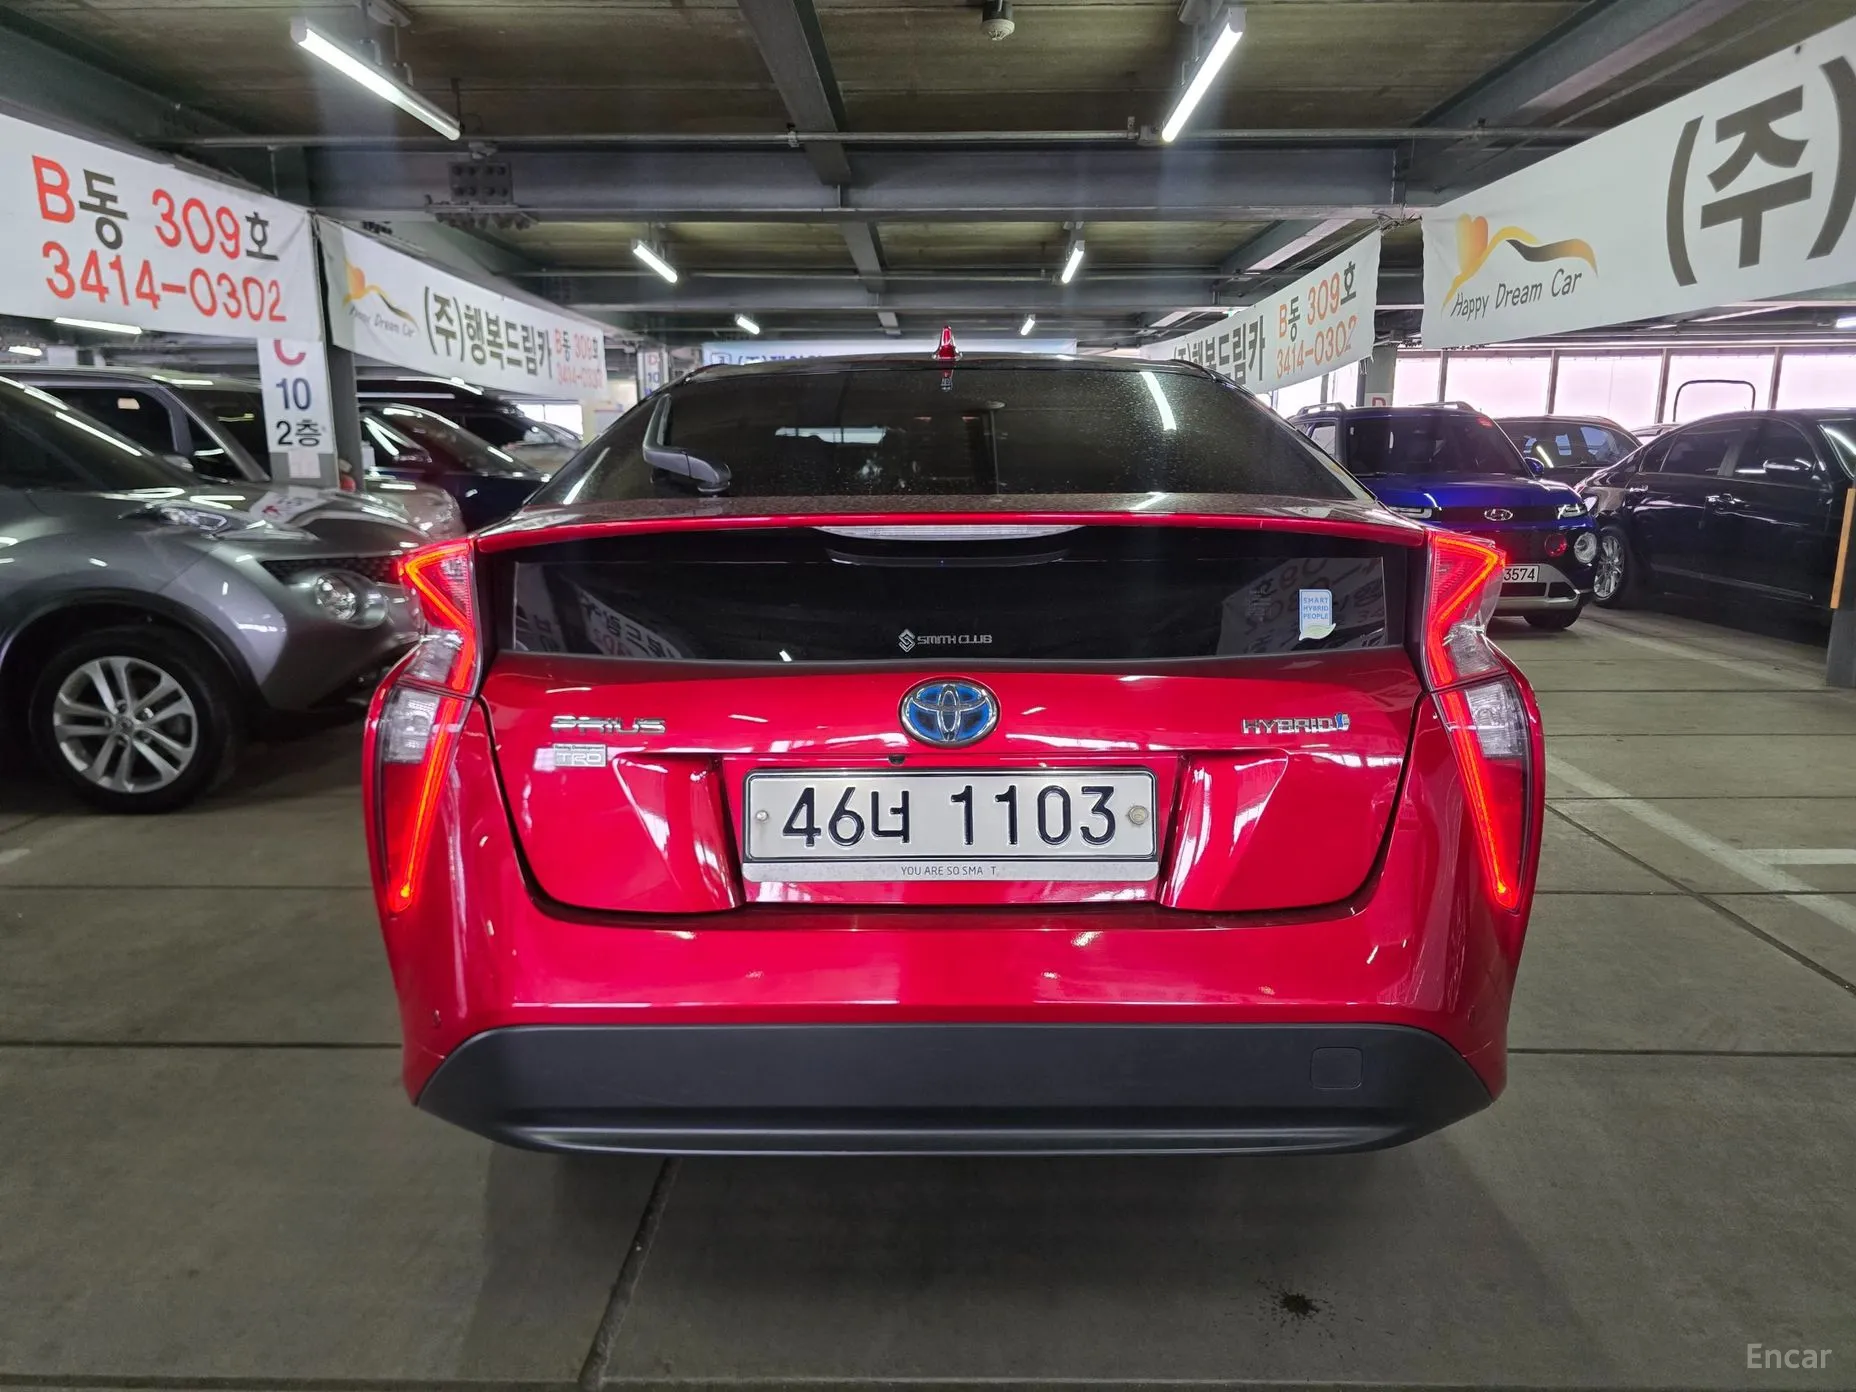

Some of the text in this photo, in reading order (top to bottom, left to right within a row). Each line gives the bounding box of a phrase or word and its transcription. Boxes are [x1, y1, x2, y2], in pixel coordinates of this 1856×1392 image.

[1667, 55, 1856, 287] (주)
[32, 155, 279, 262] B동 309호
[42, 241, 287, 322] 3414-0302
[1279, 261, 1356, 342] B동 309호
[1450, 268, 1583, 322] Happy Dream Car
[425, 286, 552, 378] (주)행복드림카
[1276, 315, 1357, 379] 3414-0302
[276, 378, 311, 410] 10
[276, 420, 321, 447] 2층
[1503, 567, 1535, 581] 3574
[917, 634, 993, 645] SMITH CLUB
[1242, 717, 1335, 734] HYBRID
[782, 785, 1117, 848] 46너 1103
[901, 866, 921, 876] YOU
[924, 866, 944, 876] ARE
[946, 866, 960, 876] SO
